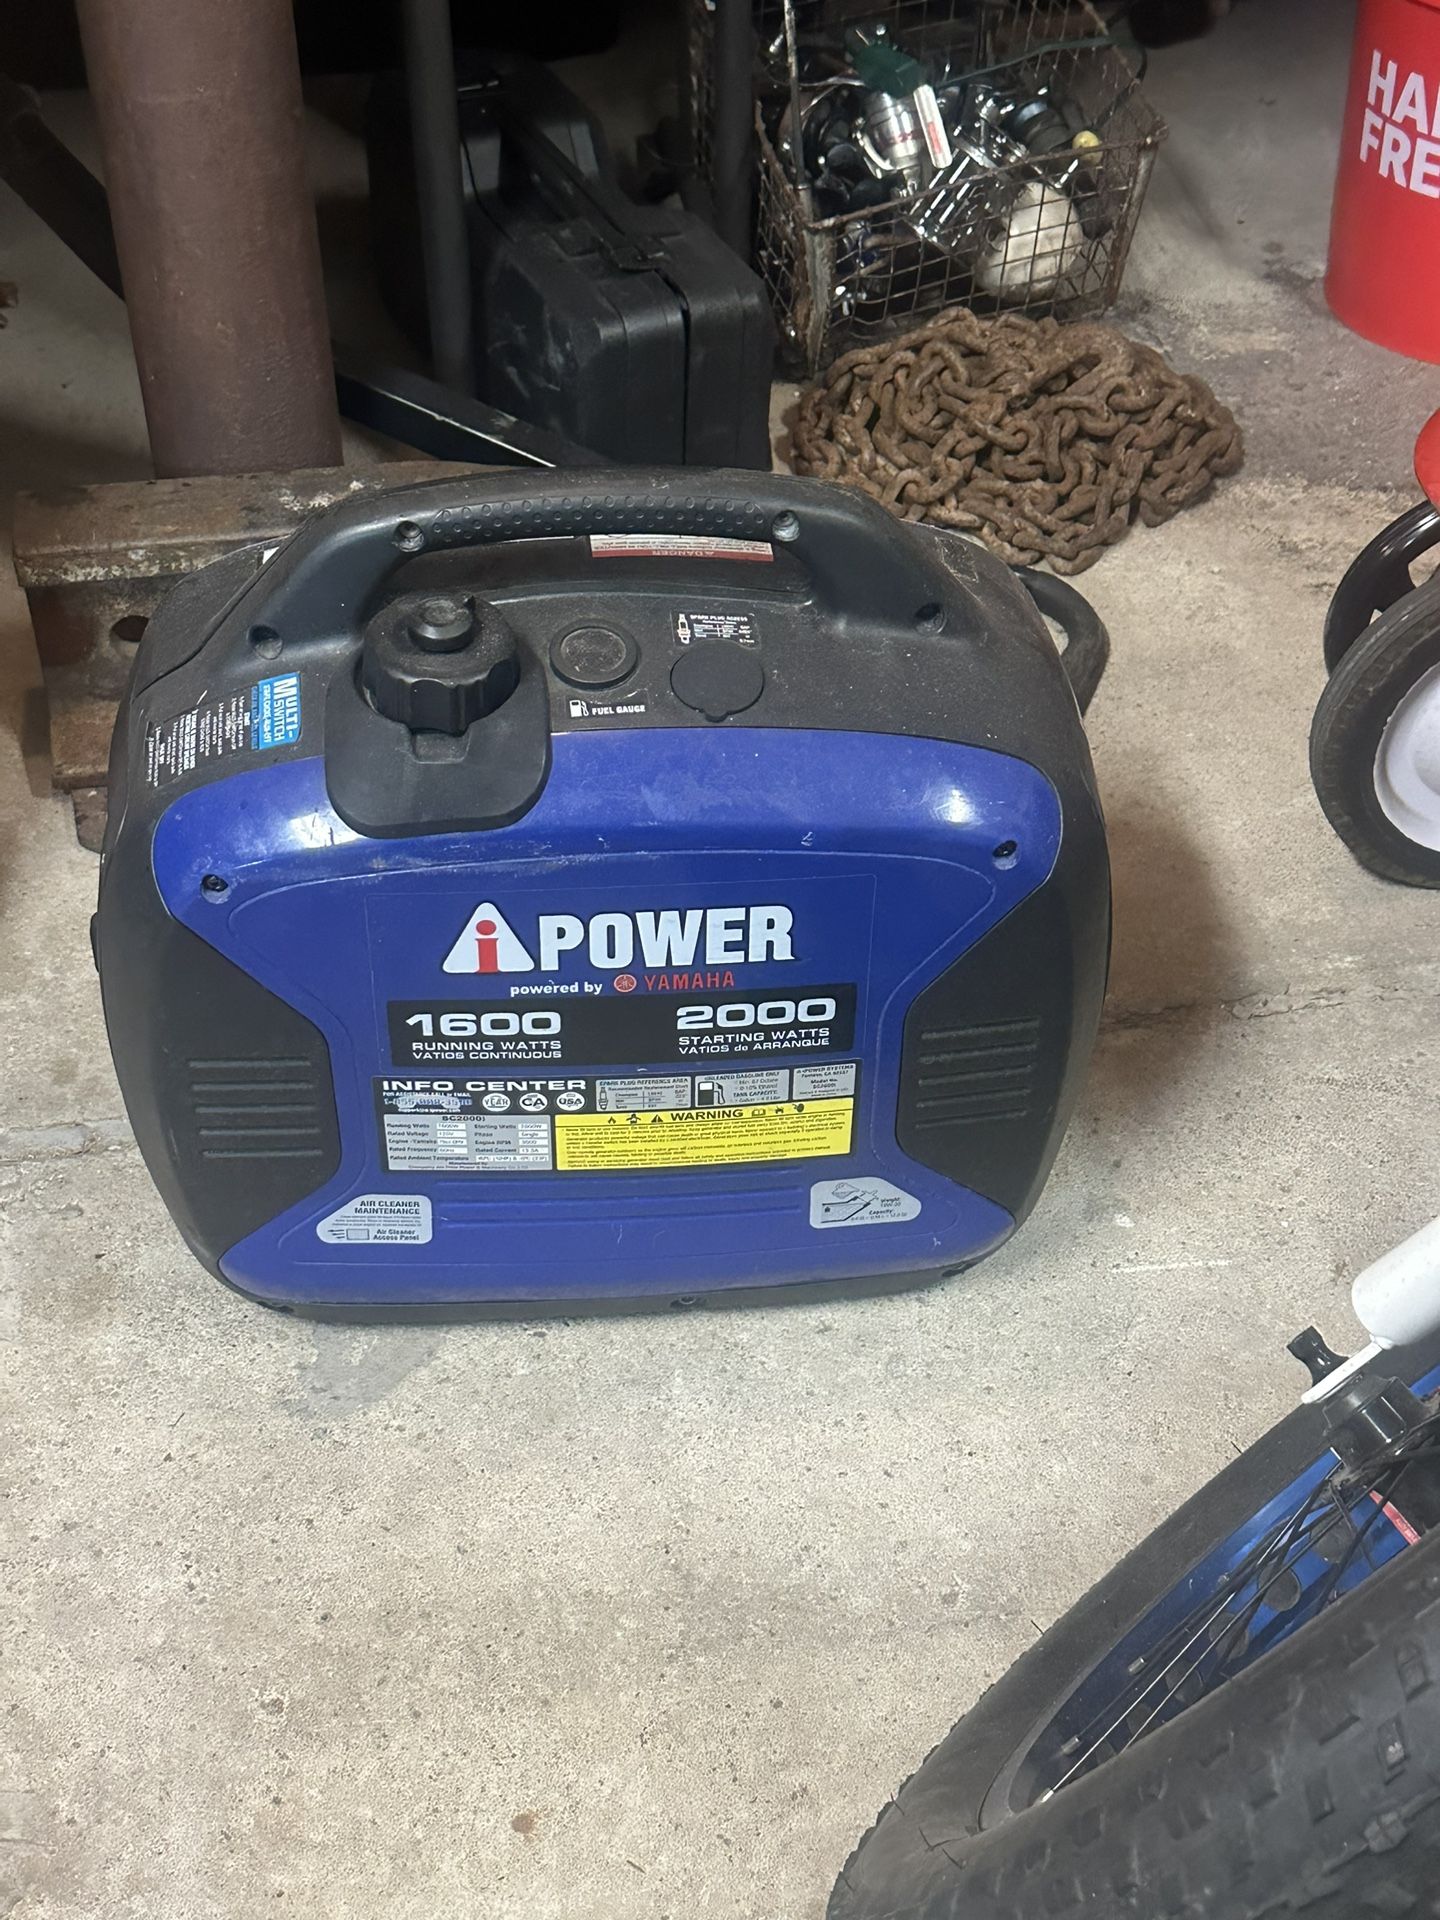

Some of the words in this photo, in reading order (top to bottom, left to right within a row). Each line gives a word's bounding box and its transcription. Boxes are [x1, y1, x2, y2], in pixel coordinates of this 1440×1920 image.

[1367, 49, 1440, 138] HA
[592, 705, 615, 716] FUEL
[616, 705, 646, 713] GAUGE
[274, 699, 285, 741] SWITCH
[510, 981, 579, 997] powered
[584, 981, 603, 995] by
[644, 971, 735, 991] YAMAHA
[677, 998, 836, 1030] 2000
[405, 1011, 561, 1036] 1600
[679, 1033, 764, 1045] STARTING
[771, 1028, 830, 1040] WATTS
[412, 1041, 493, 1051] RUNNING
[501, 1040, 561, 1050] WATTS
[679, 1045, 729, 1054] VATIOS
[753, 1038, 830, 1051] ARRANQUE
[469, 1051, 561, 1059] CONTINUOUS
[383, 1081, 454, 1091] INFO
[466, 1080, 586, 1091] CENTER
[521, 1098, 545, 1106] CA
[670, 1109, 744, 1121] WARNING
[354, 1207, 420, 1215] MAINTENANCE
